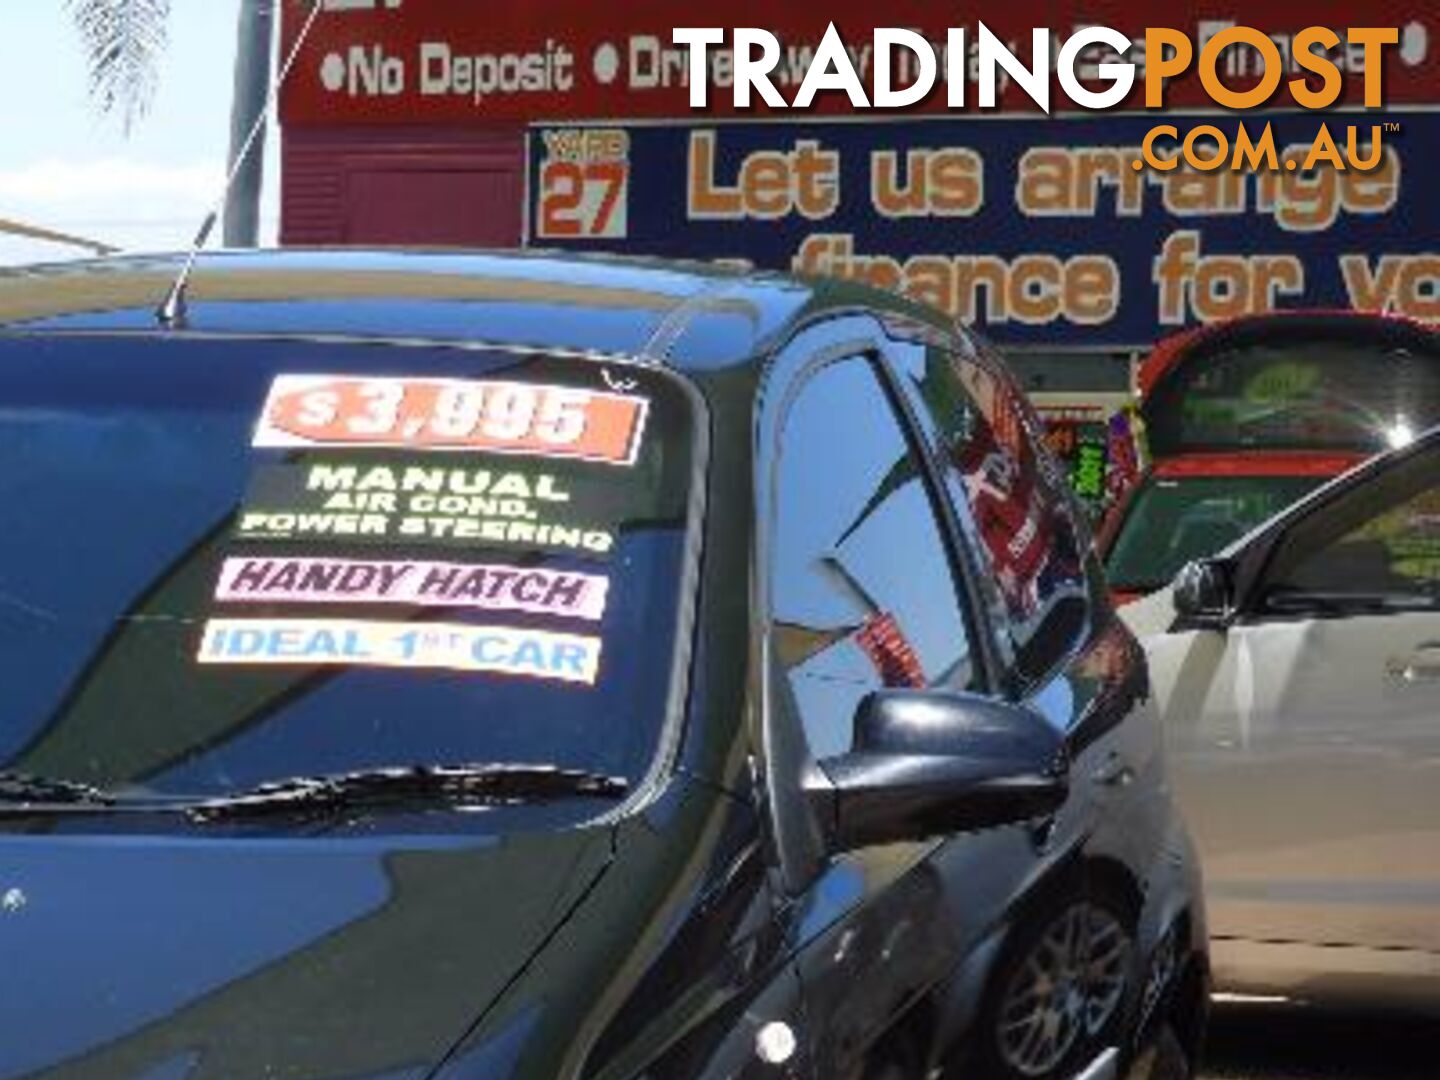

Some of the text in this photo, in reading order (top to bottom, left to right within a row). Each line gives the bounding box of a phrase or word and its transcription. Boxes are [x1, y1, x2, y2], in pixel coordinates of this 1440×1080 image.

[348, 45, 404, 96] No
[420, 41, 574, 105] Deposit
[542, 162, 627, 236] 27
[687, 129, 1400, 231] Let us arrange
[1153, 230, 1304, 322] for
[306, 464, 570, 502] MANUAL
[323, 493, 538, 520] AIR COND.
[240, 513, 614, 552] POWER STEERING
[230, 561, 587, 607] HANDY HATCH
[209, 629, 372, 659] IDEAL
[471, 634, 588, 674] CAR
